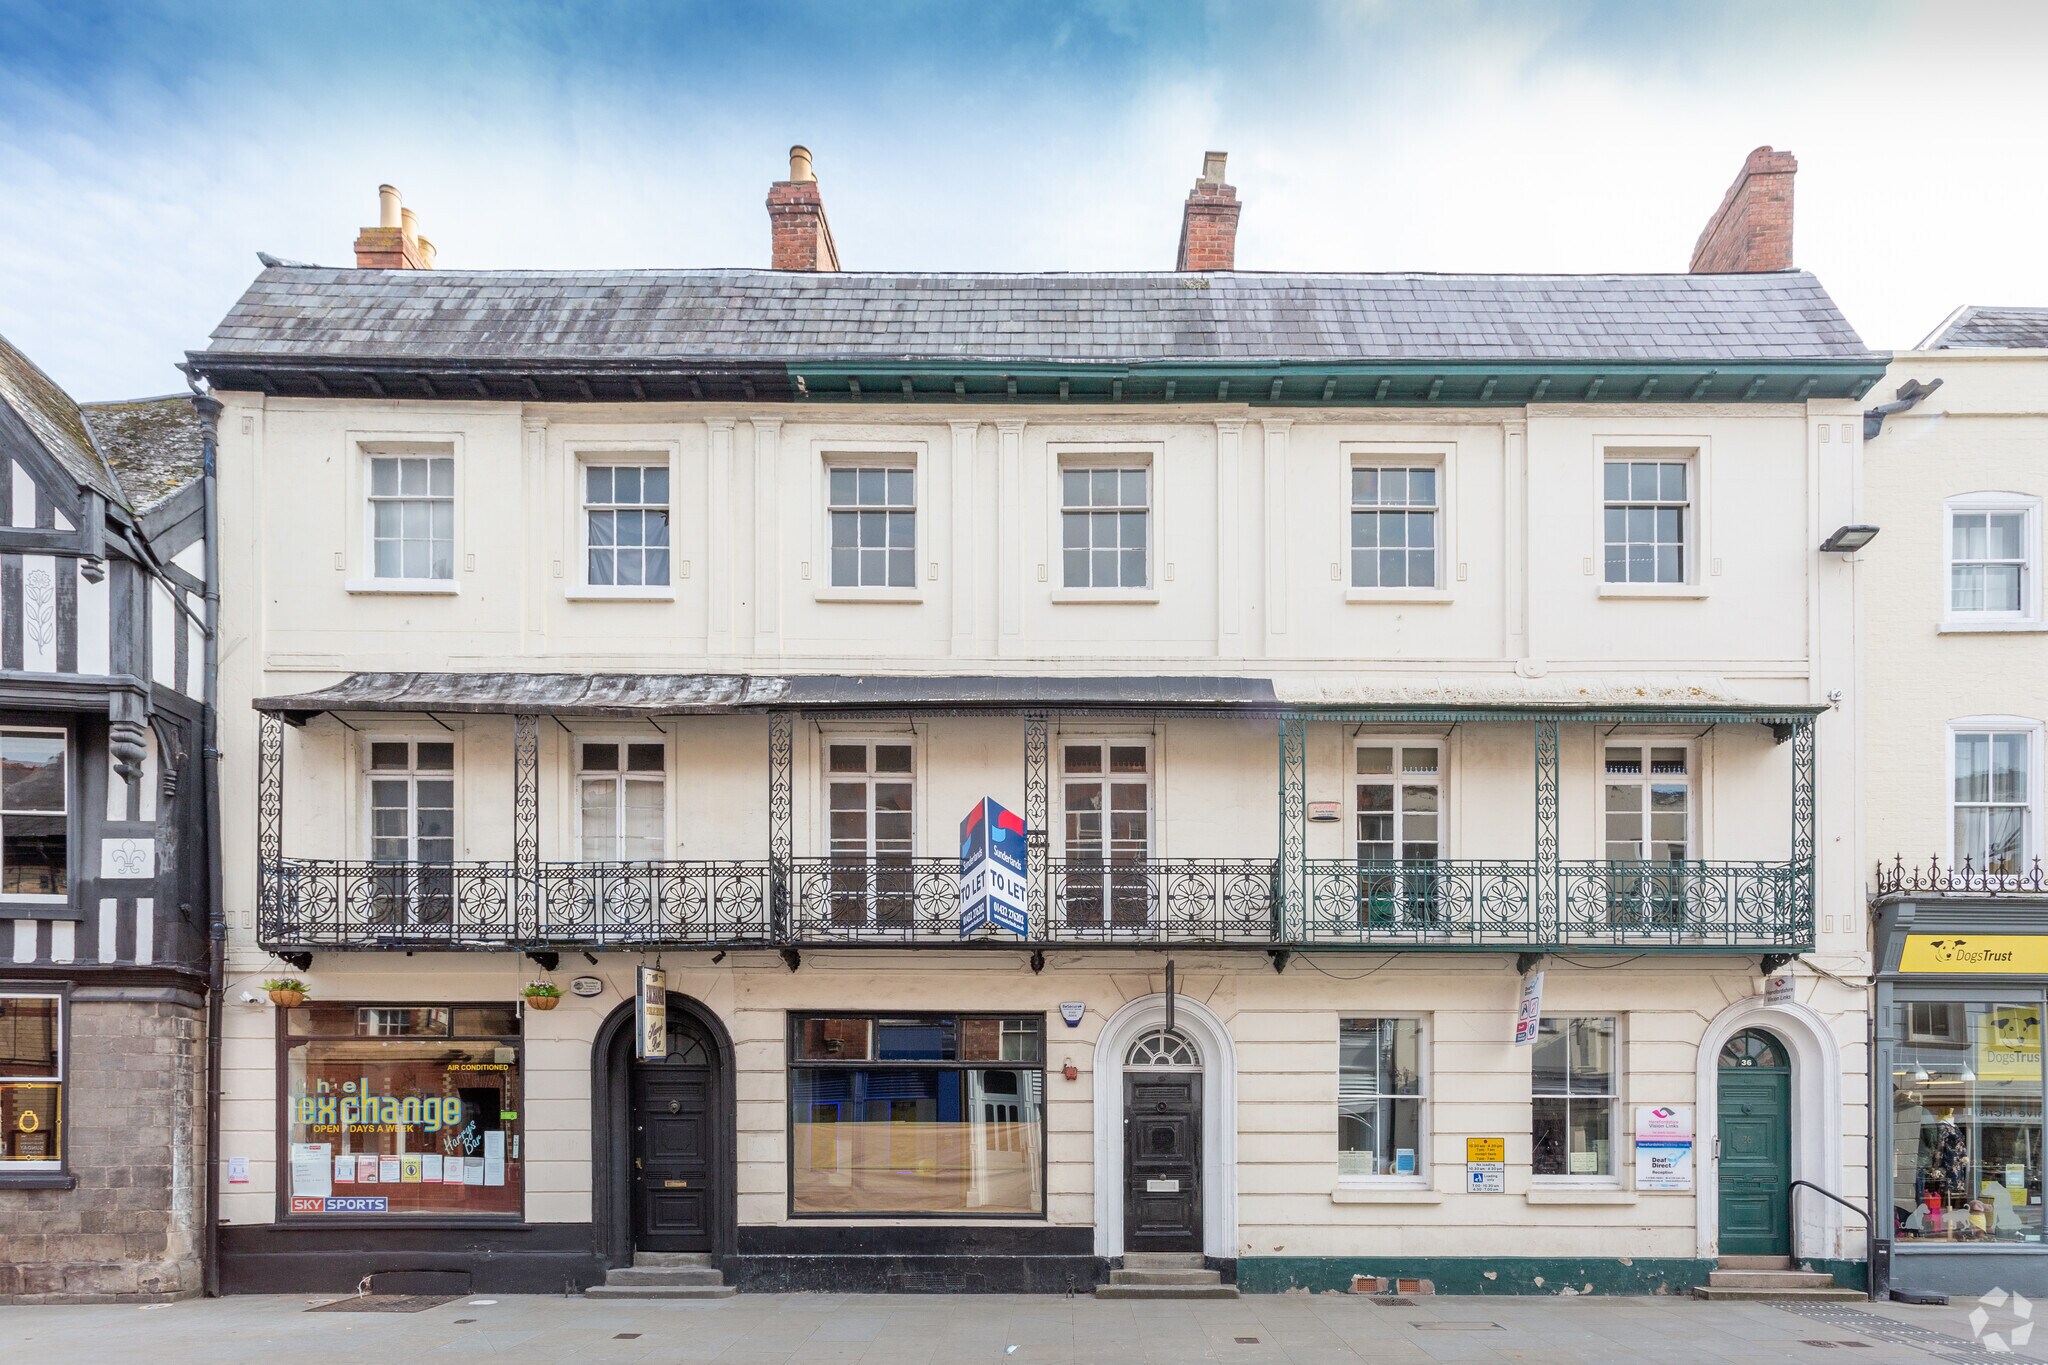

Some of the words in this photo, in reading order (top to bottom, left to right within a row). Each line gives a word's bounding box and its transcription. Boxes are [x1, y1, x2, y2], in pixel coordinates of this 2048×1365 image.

[993, 844, 1022, 871] Sunderlands
[961, 883, 971, 904] TO
[972, 869, 986, 896] LET
[990, 868, 1004, 891] TO
[1007, 878, 1026, 903] LET
[1987, 1050, 2040, 1065] DogsTrus
[296, 1077, 462, 1133] exchange
[313, 1124, 340, 1133] OPEN
[349, 1124, 375, 1133] DAYS
[376, 1124, 385, 1133] A
[385, 1124, 414, 1133] WEEK
[443, 1120, 476, 1155] Harrys
[463, 1134, 481, 1155] Bar
[294, 1199, 322, 1210] SKY
[327, 1199, 385, 1210] SPORTS
